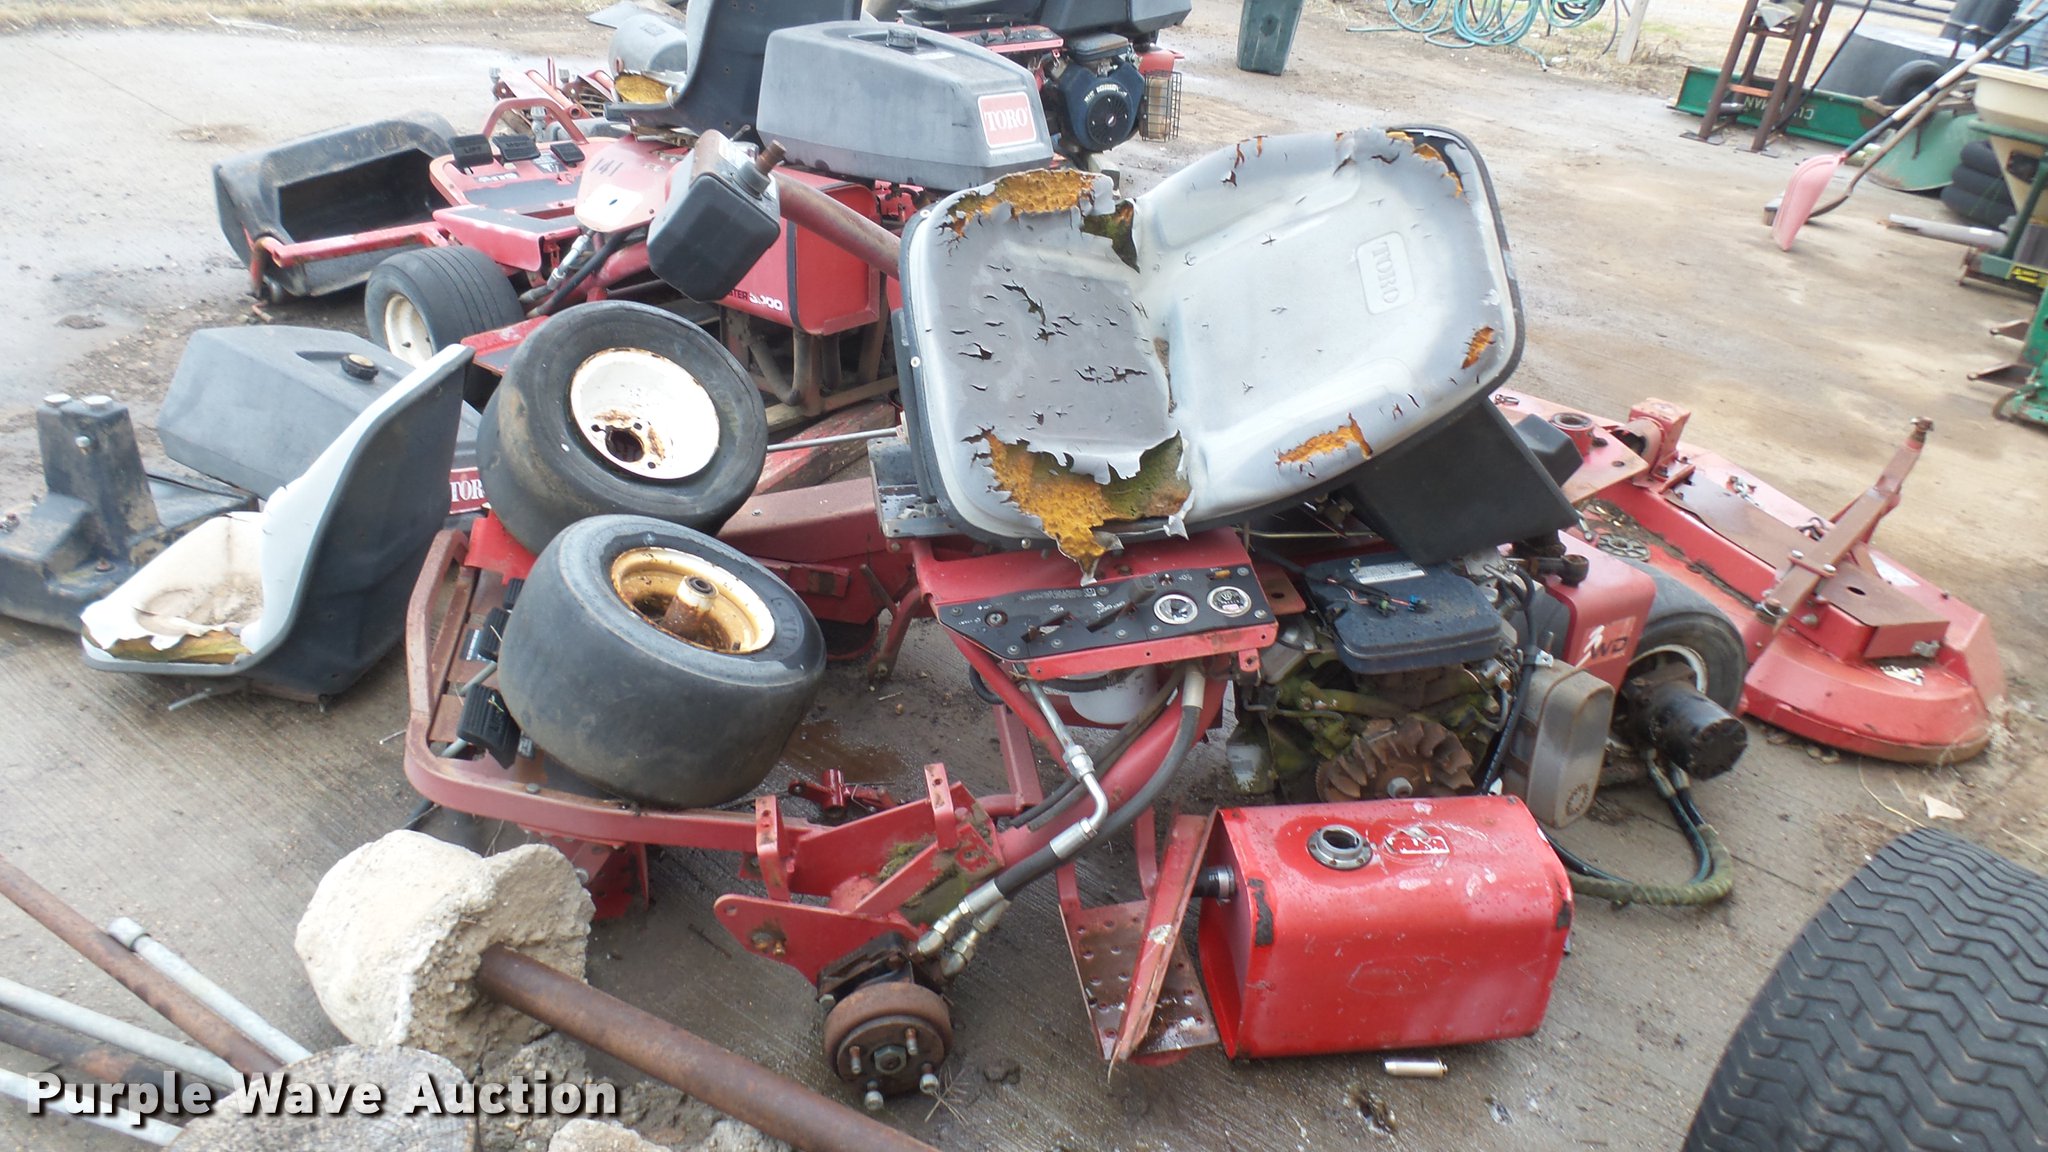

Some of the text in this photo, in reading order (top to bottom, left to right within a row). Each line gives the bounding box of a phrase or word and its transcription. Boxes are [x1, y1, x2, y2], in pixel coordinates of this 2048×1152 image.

[983, 107, 1028, 132] TORO
[1372, 241, 1400, 303] TORO
[450, 479, 486, 502] TOR
